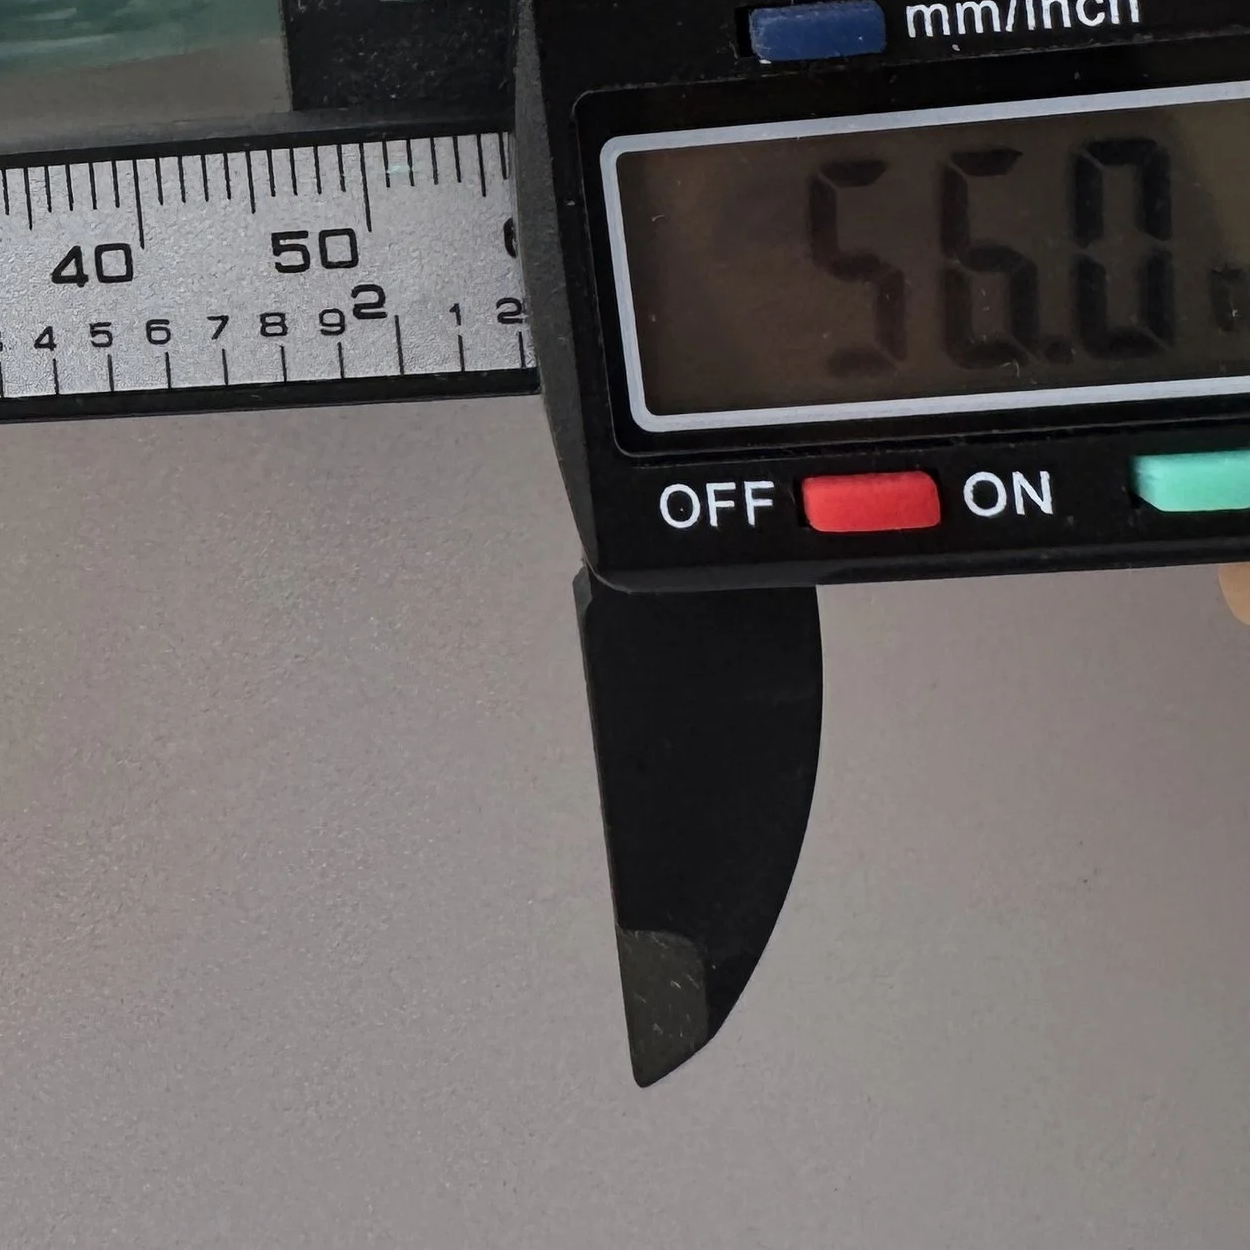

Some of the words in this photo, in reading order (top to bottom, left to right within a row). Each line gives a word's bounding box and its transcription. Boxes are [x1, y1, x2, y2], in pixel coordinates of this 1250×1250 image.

[50, 242, 134, 288] 40
[270, 227, 360, 274] 50
[807, 137, 1172, 376] 56.0
[33, 325, 57, 352] 4
[89, 321, 114, 349] 5
[145, 318, 172, 346] 6
[207, 314, 230, 340] 7
[259, 311, 289, 338] 8
[318, 307, 347, 337] 9
[350, 283, 388, 321] 2
[448, 302, 462, 326] 1
[495, 296, 524, 325] 2
[659, 480, 775, 529] OFF
[963, 470, 1053, 517] ON
